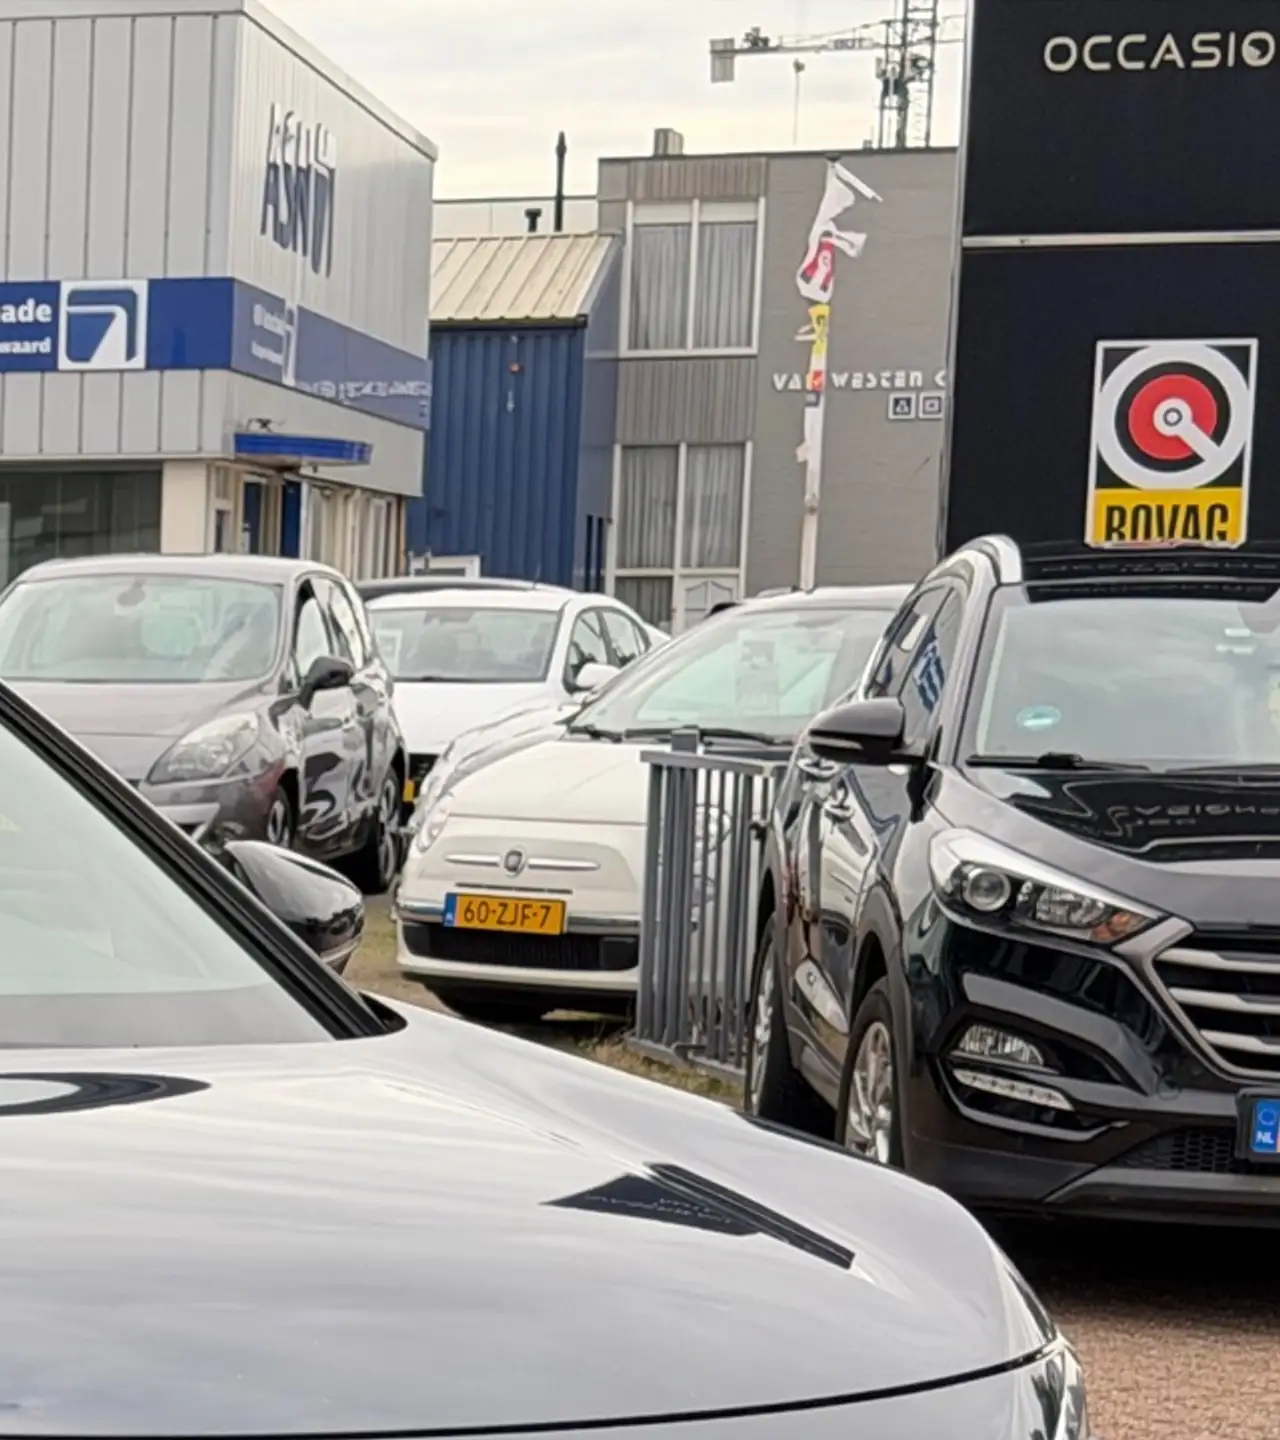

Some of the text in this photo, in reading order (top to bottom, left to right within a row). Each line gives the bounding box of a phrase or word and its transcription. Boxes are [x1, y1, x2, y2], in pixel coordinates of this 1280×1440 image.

[1043, 30, 1276, 72] OCCASIO
[1104, 503, 1230, 541] BOVAG
[463, 900, 551, 928] 60-ZJF-7
